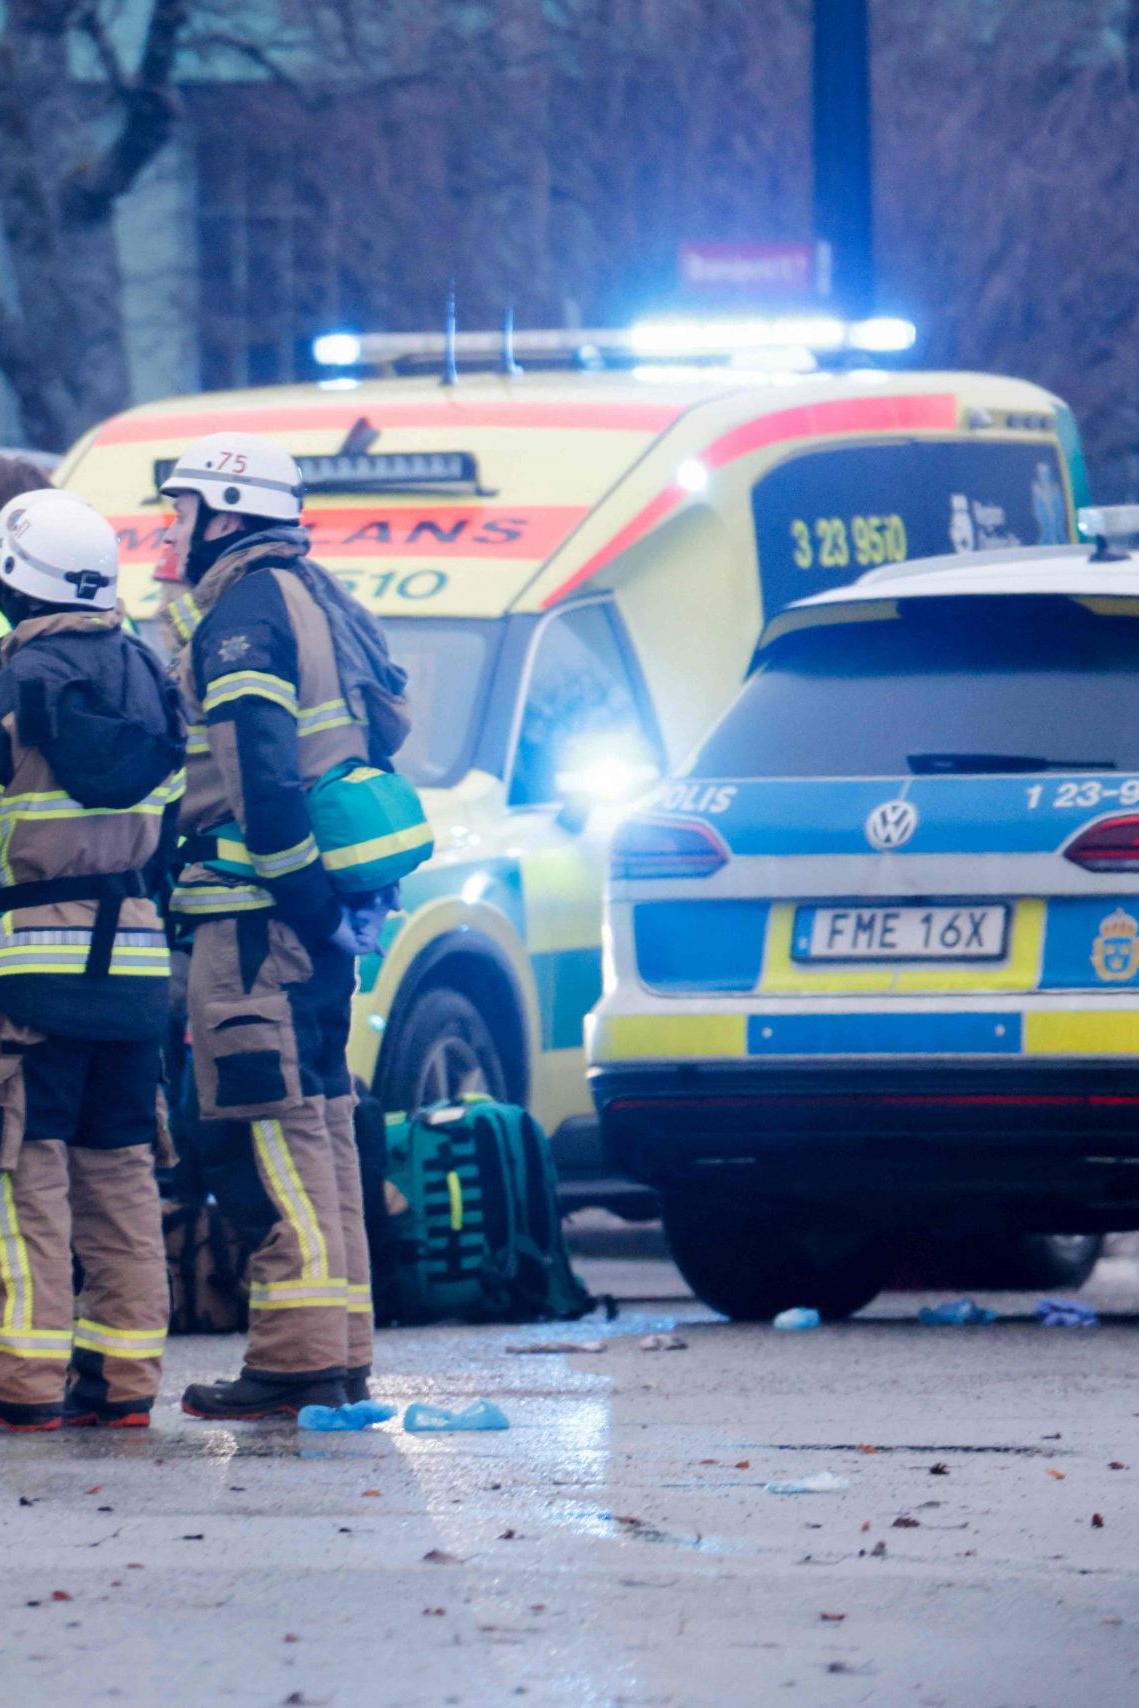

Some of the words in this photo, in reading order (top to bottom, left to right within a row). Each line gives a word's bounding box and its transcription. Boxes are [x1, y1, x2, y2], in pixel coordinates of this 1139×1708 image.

[215, 450, 248, 474] 75
[791, 518, 813, 569] 3
[816, 517, 850, 568] 23
[1025, 783, 1044, 810] 1
[826, 912, 901, 949] FME
[919, 911, 988, 948] 16X
